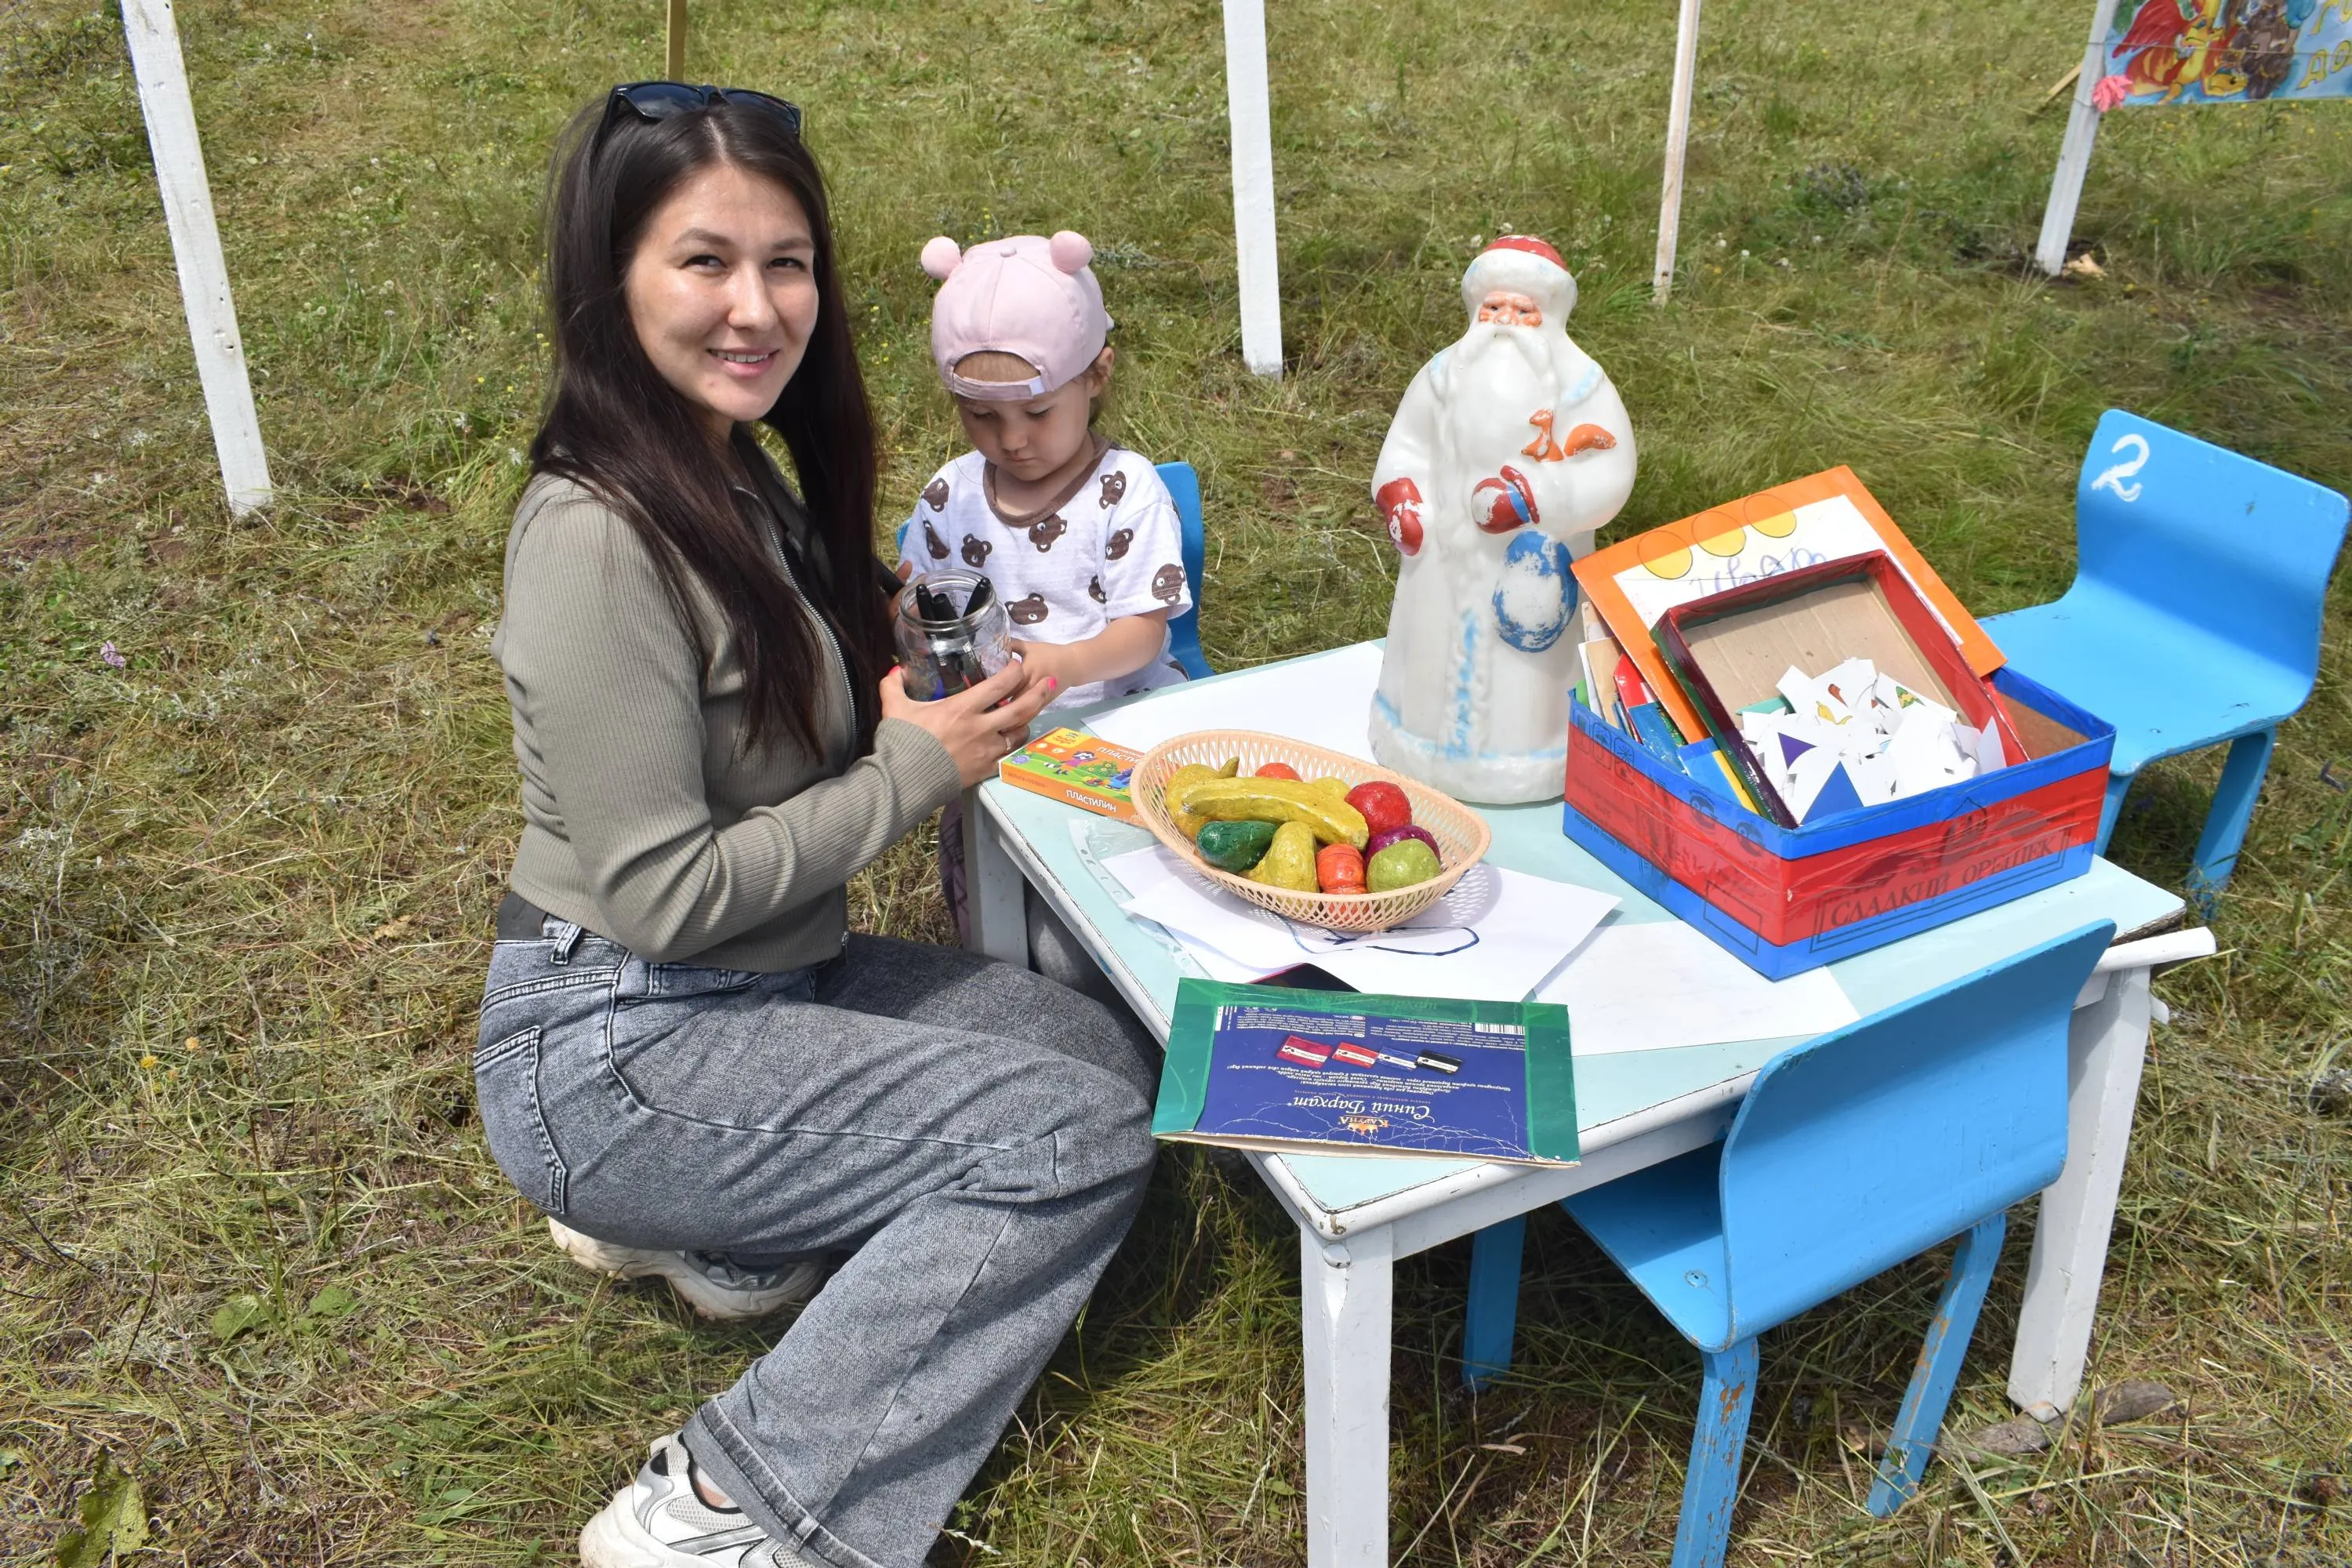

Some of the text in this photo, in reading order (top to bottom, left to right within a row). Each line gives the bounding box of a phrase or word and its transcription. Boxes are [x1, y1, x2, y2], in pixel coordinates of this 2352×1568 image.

[2091, 434, 2150, 502] 2
[1065, 789, 1117, 813] ПЛАСТИЛИН
[1830, 870, 1951, 927] СЛАДКИЙ
[1962, 834, 2056, 886] ОРЕШЕК
[1293, 1094, 1366, 1114] Бархат
[1370, 1101, 1435, 1123] Синий
[1339, 1116, 1389, 1127] КАРУНА
